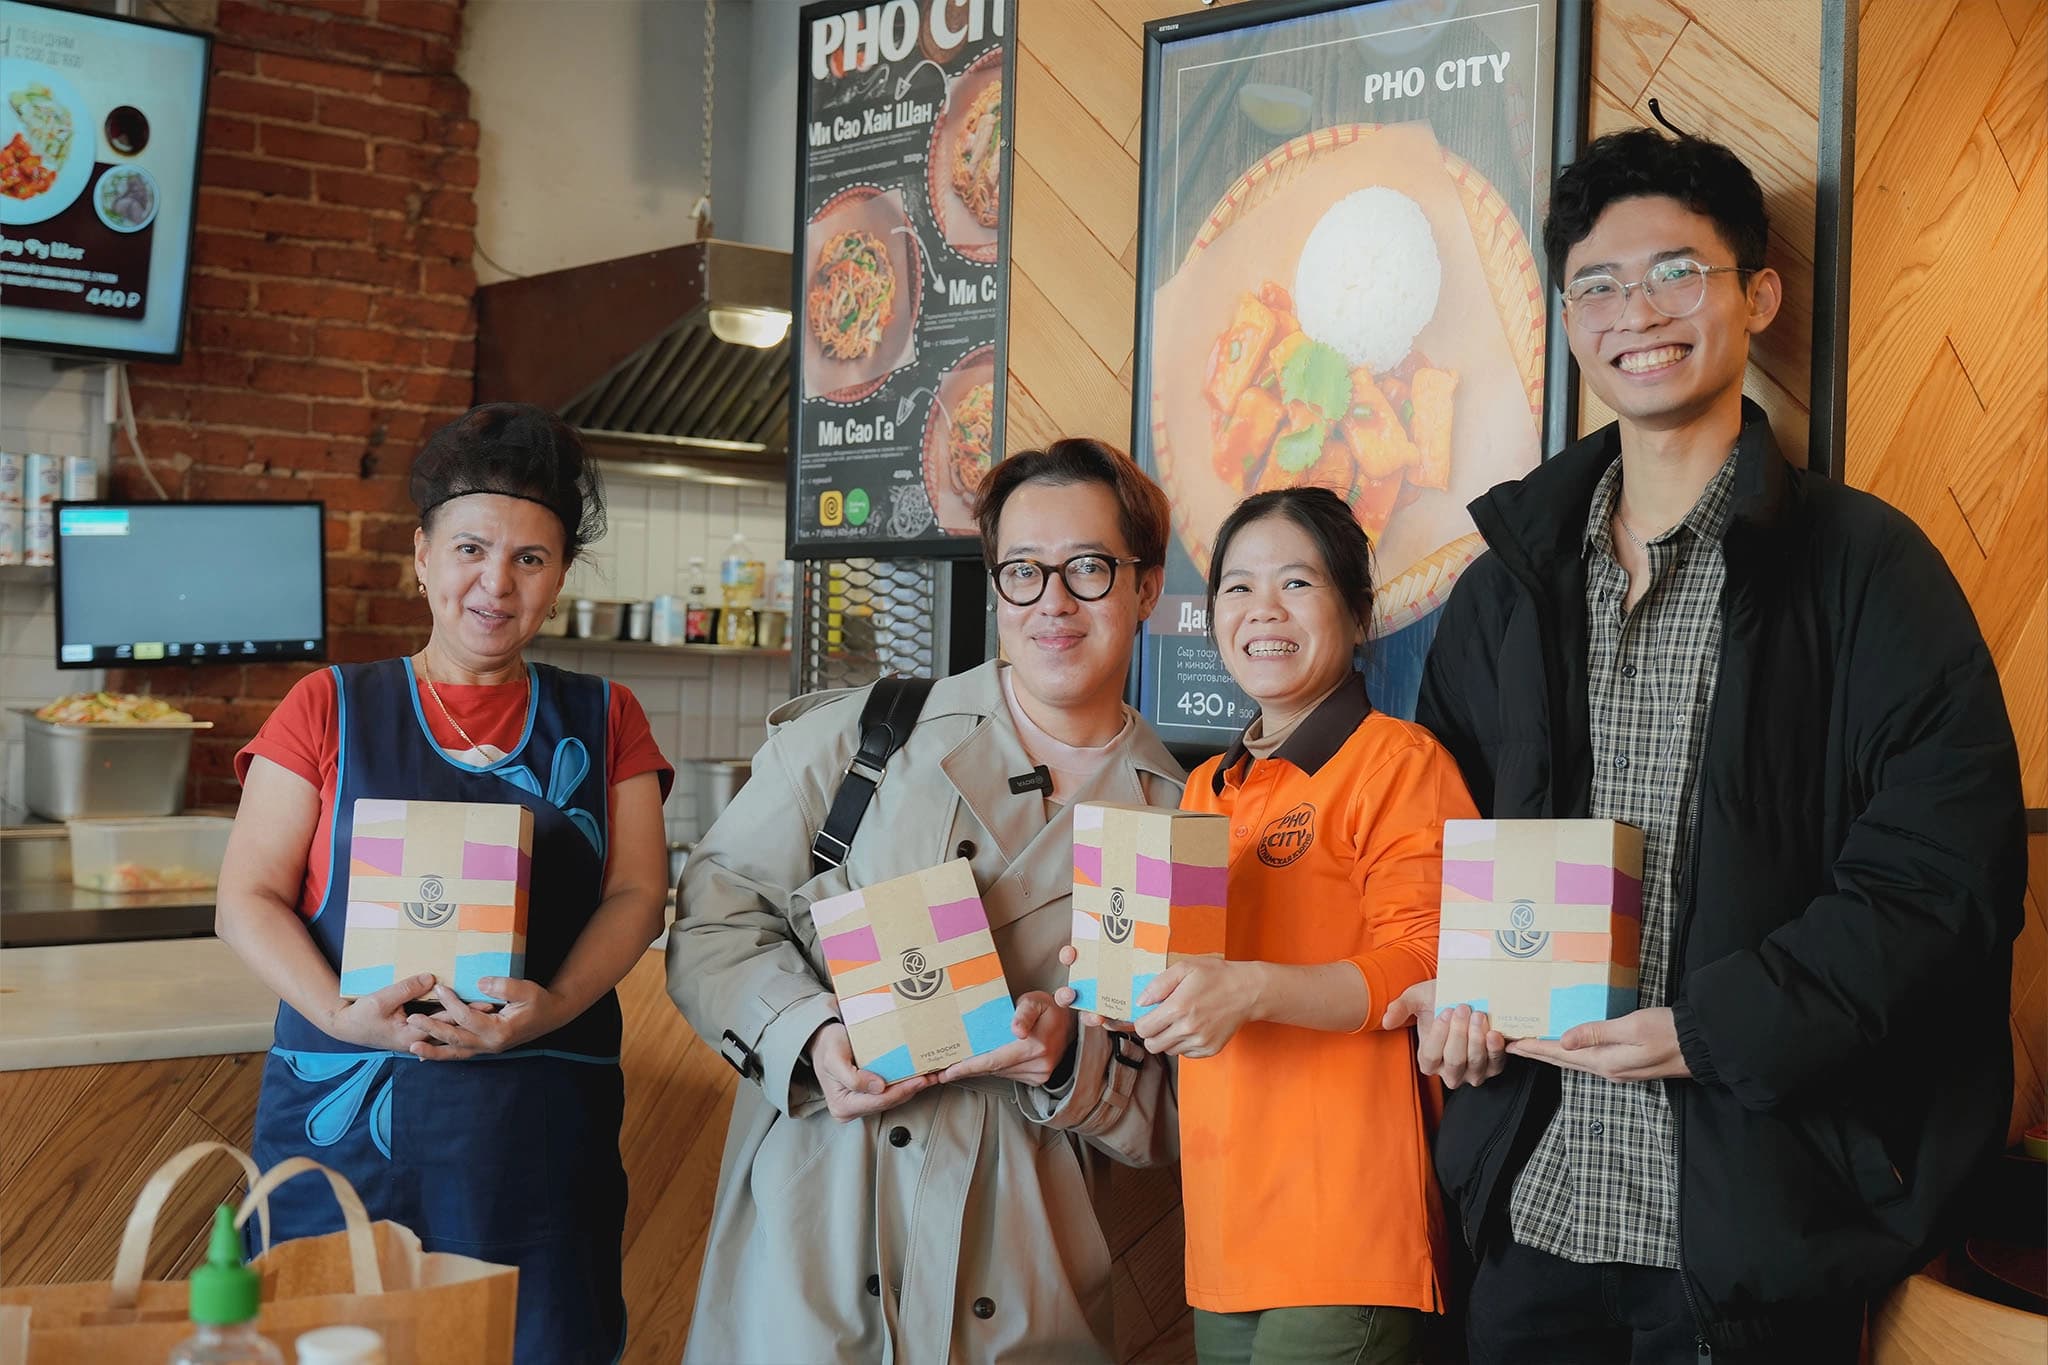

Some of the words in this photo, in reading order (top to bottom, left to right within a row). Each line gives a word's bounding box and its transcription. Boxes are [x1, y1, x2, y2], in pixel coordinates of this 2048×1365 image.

[812, 0, 920, 80] PHO
[1364, 67, 1426, 103] PHO
[1435, 52, 1511, 91] CITY
[809, 121, 831, 146] Ми
[833, 115, 861, 142] Сао
[862, 103, 893, 135] Хай
[895, 100, 933, 128] Шан
[85, 287, 127, 309] 440
[949, 279, 977, 306] Ми
[818, 420, 843, 446] Ми
[845, 418, 873, 444] Сао
[875, 415, 894, 441] Га
[1177, 646, 1195, 660] Сыр
[1196, 649, 1218, 662] тофу
[1177, 691, 1224, 717] 430
[1277, 810, 1311, 830] PHO
[1266, 828, 1307, 848] CITY
